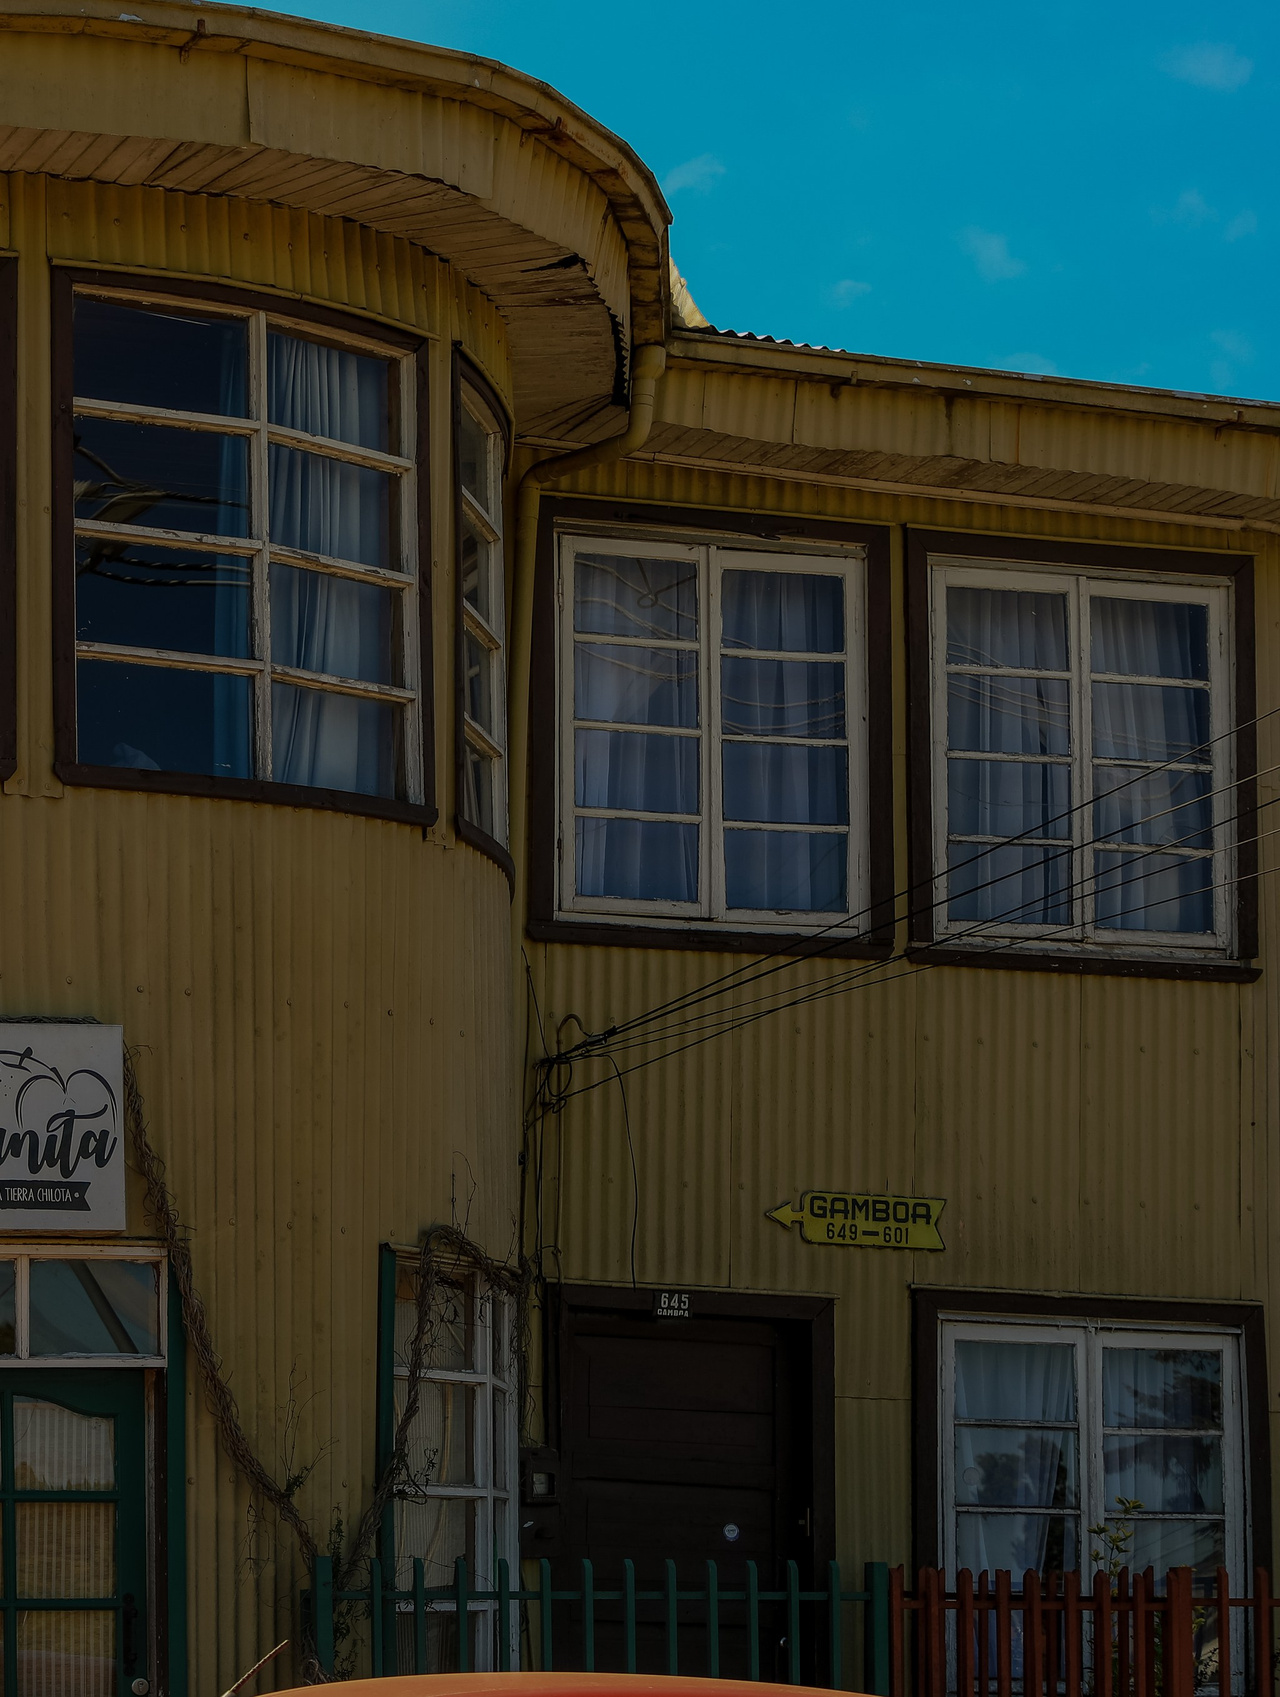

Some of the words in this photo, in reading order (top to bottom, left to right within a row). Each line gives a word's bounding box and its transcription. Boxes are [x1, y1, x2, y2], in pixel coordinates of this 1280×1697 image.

[5, 1187, 35, 1202] TIERRA
[37, 1187, 72, 1203] CHILOTA
[809, 1195, 932, 1225] GAMBOA
[660, 1292, 689, 1309] 645
